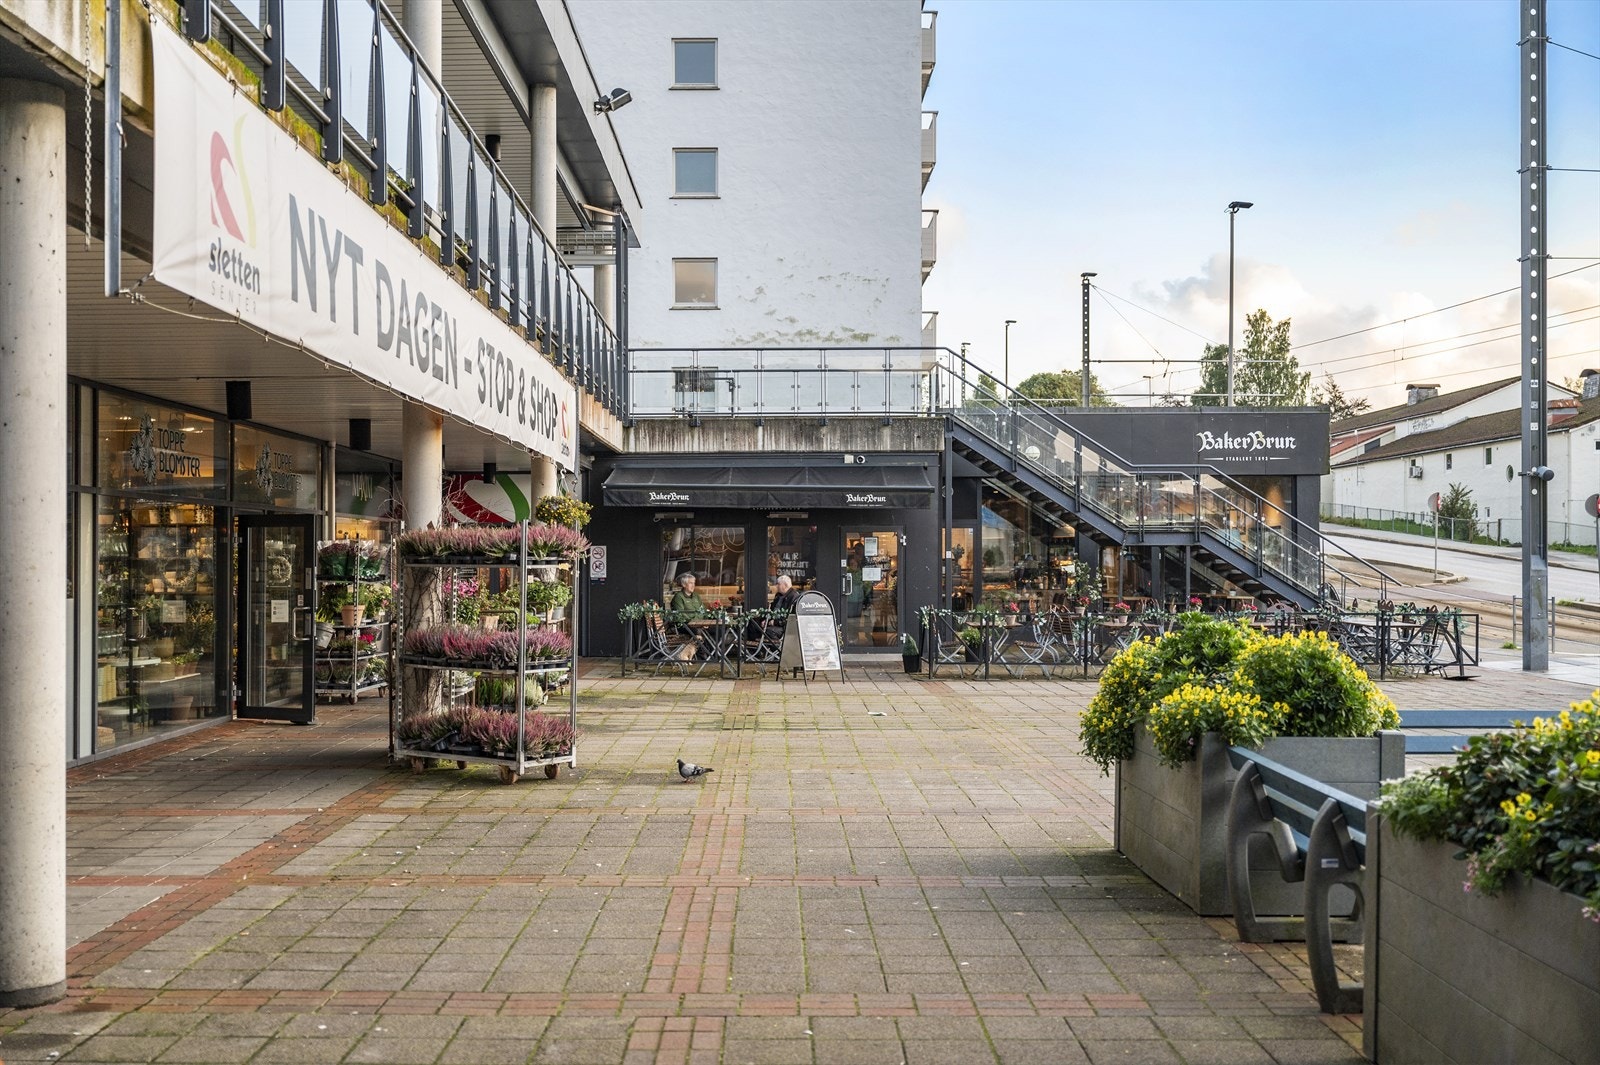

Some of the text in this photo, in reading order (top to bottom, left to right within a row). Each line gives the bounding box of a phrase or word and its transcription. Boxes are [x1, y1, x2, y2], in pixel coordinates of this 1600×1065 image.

[208, 236, 261, 295] sletten
[289, 193, 364, 336] NYT
[376, 258, 458, 390] DAGEN
[477, 337, 515, 417] STOP
[518, 367, 526, 425] &
[530, 375, 558, 441] SHOP
[158, 428, 186, 453] TOPPE
[1196, 430, 1297, 453] BakerBrun
[159, 452, 201, 478] BLOMSTER
